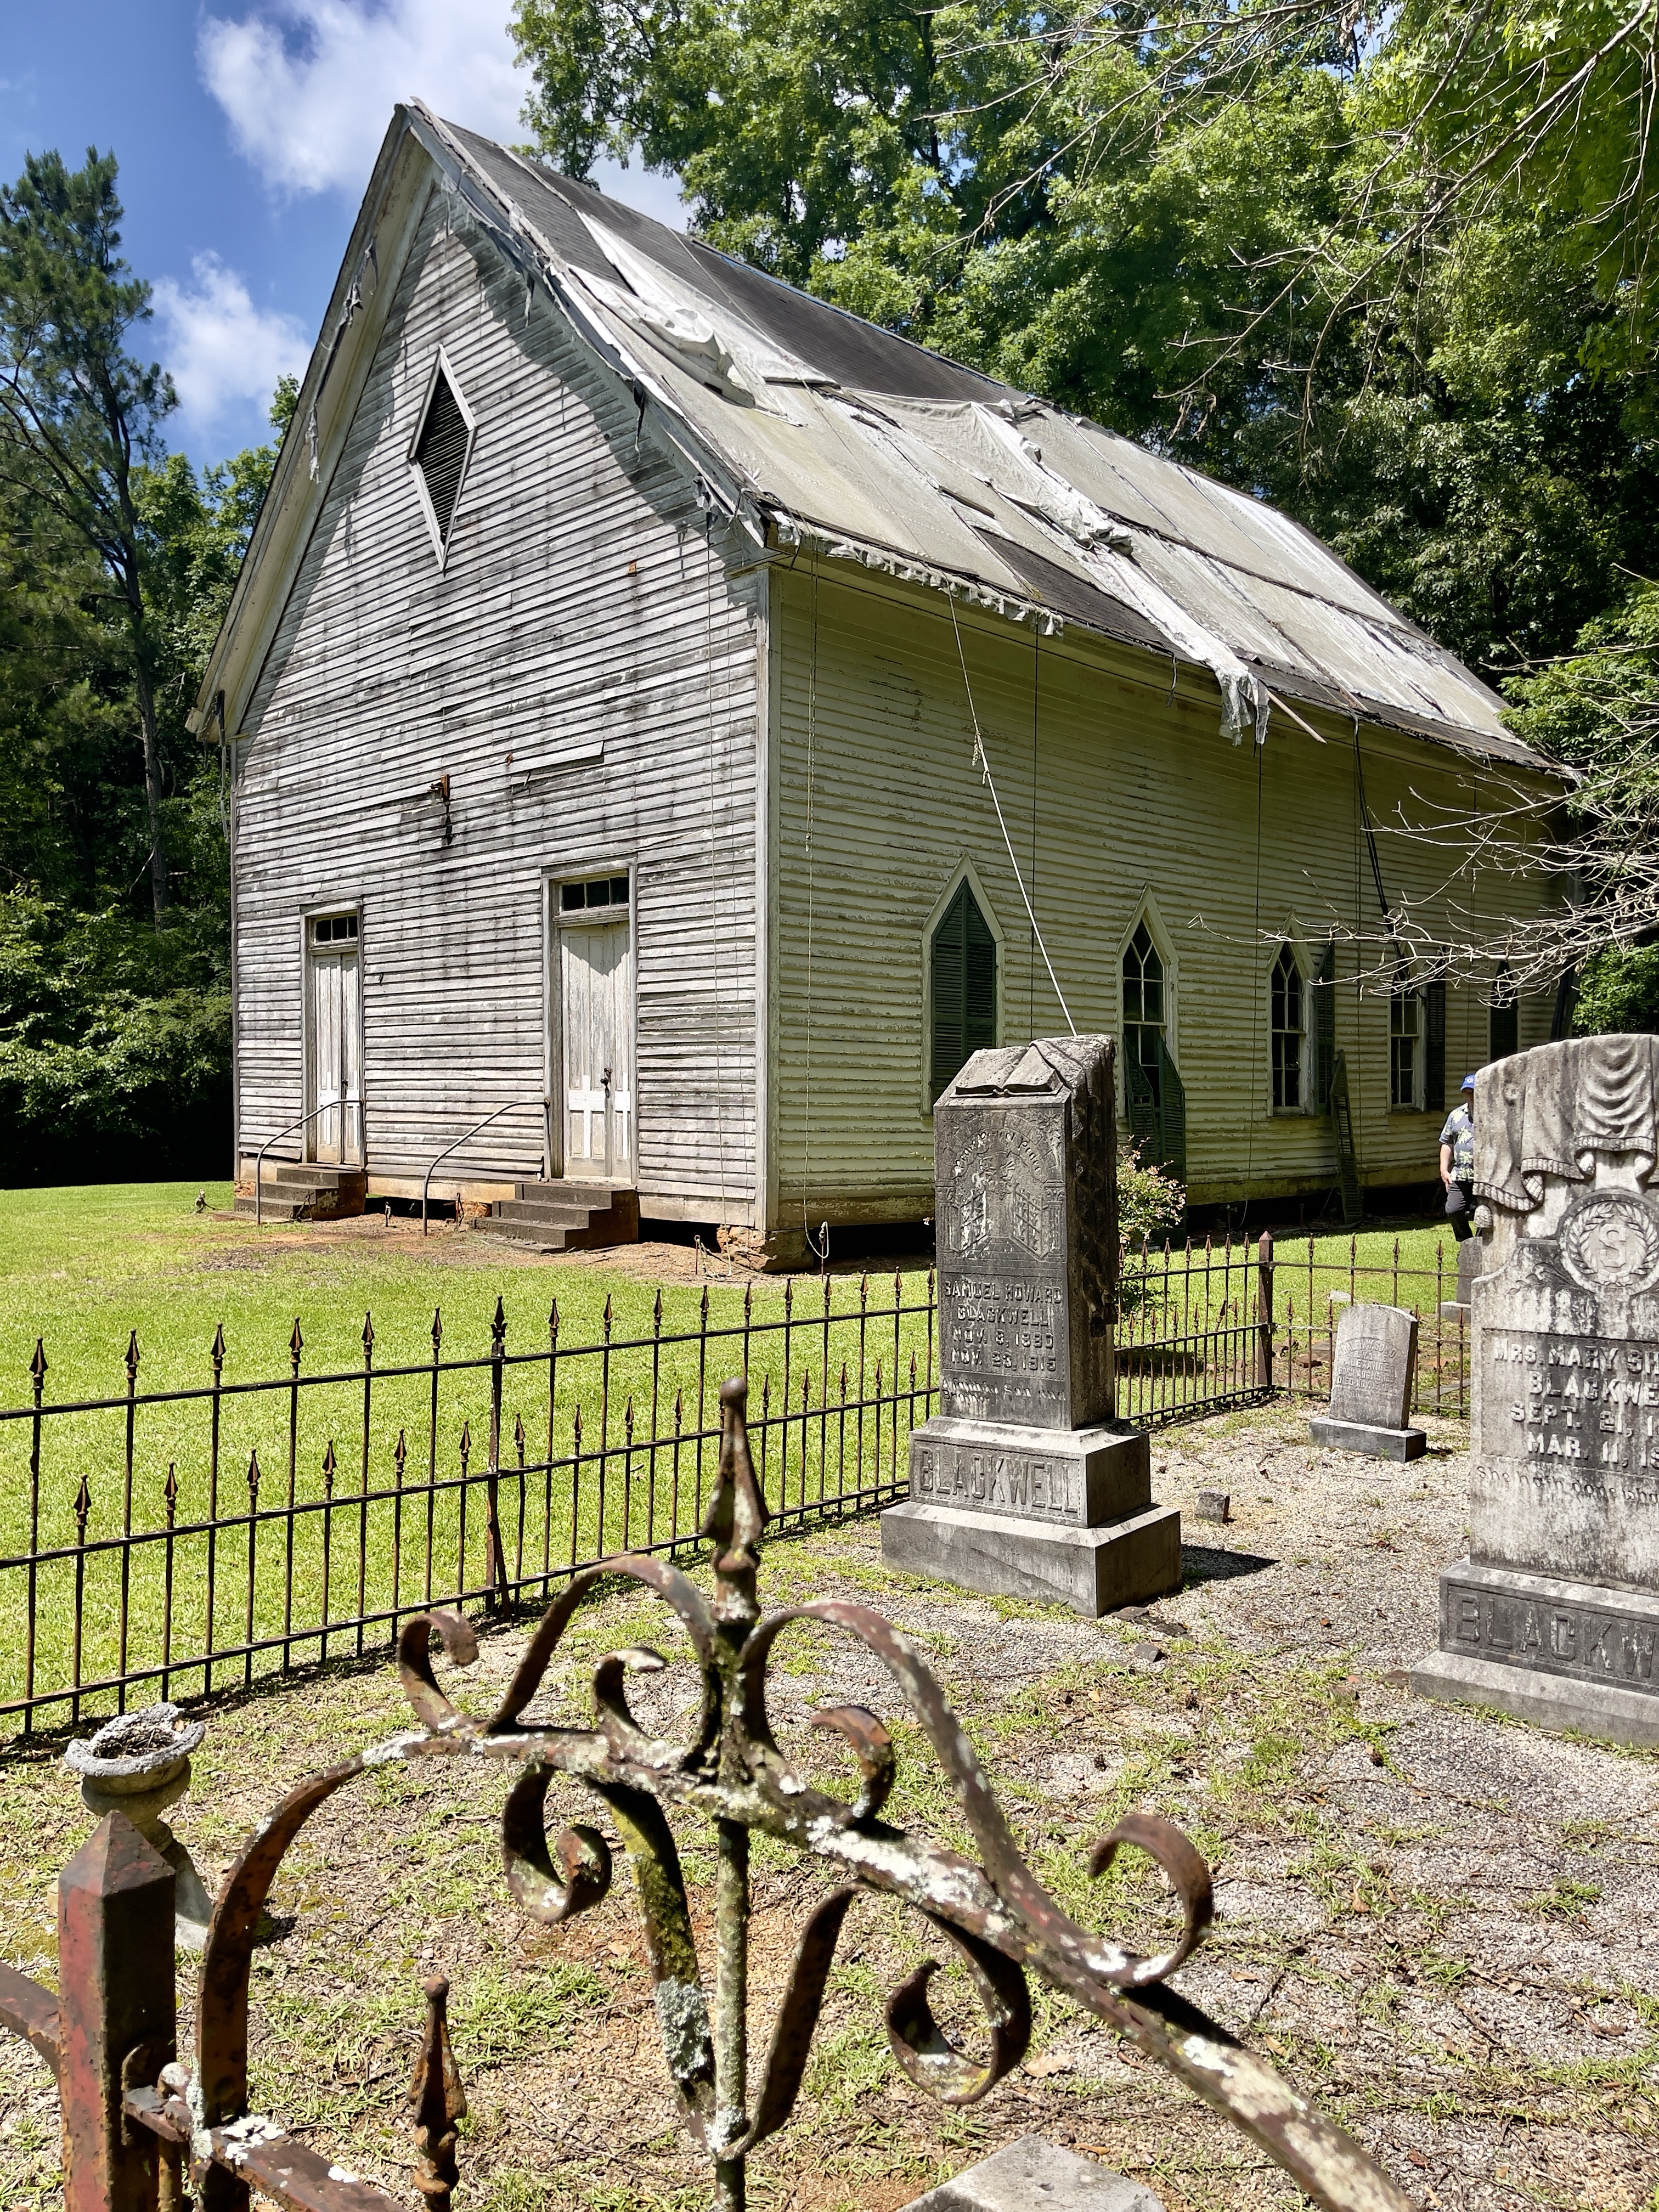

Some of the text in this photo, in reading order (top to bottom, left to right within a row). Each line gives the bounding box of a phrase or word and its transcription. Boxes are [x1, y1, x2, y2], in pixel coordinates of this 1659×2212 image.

[1599, 1223, 1627, 1267] S
[944, 1280, 1062, 1304] SAMUEL HOWARD
[957, 1304, 1048, 1326] BLACKWELL
[953, 1327, 987, 1344] NOV.
[951, 1347, 982, 1365] NOV.
[1022, 1354, 1056, 1371] 1915
[1548, 1344, 1618, 1370] MARY
[1510, 1400, 1583, 1430] SEPT.
[1527, 1431, 1589, 1460] MAR.
[1602, 1441, 1628, 1468] 11,
[919, 1447, 1077, 1513] BLACKWELL
[1477, 1466, 1509, 1482] She
[1457, 1594, 1656, 1678] BLACKW
